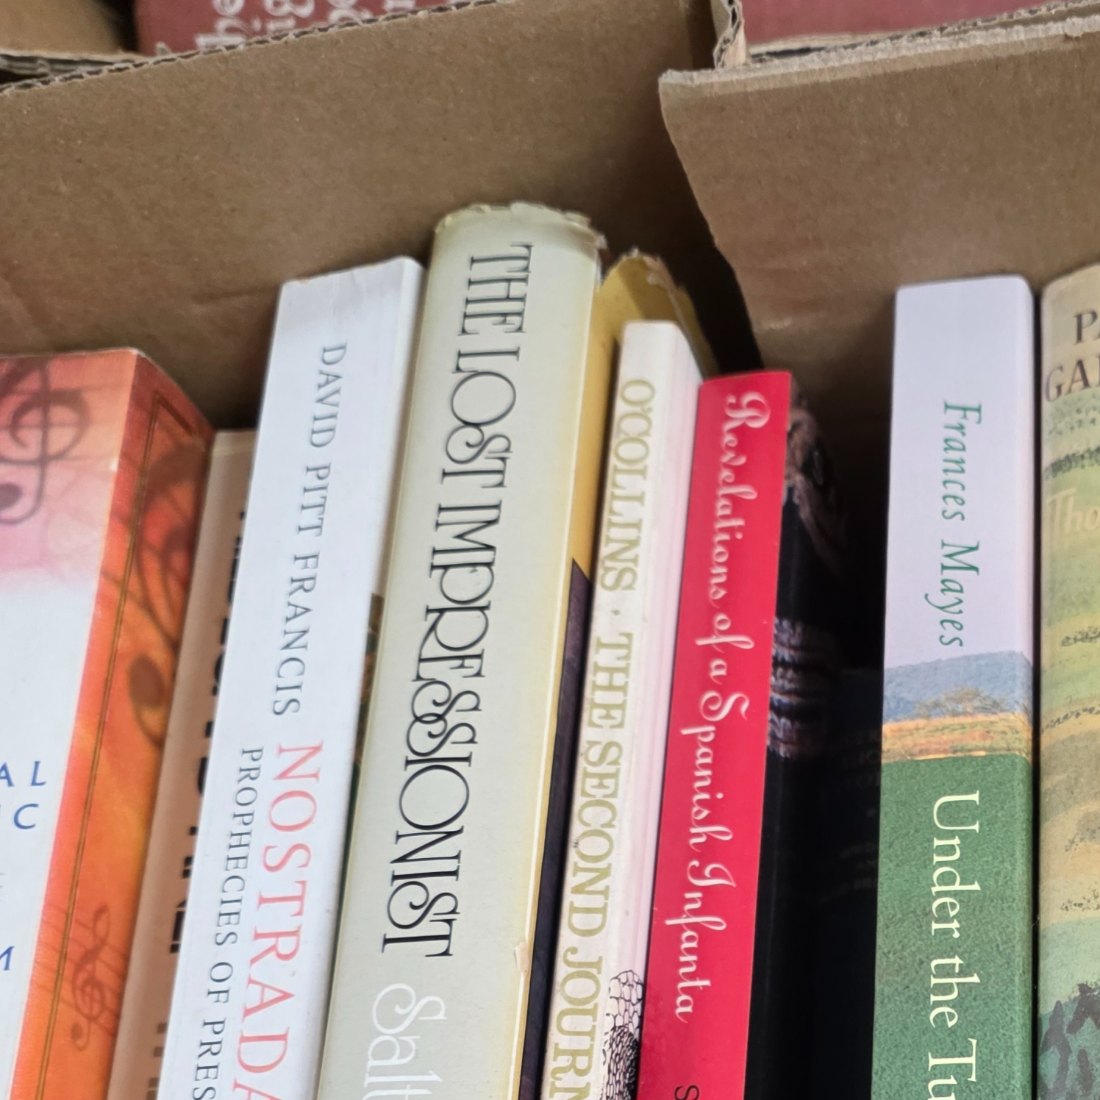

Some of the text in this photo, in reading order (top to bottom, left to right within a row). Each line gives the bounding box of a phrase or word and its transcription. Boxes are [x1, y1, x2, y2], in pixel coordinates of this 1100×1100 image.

[271, 342, 348, 717] DAVID PITT FRANCIS
[600, 379, 656, 593] O'COLLINS
[924, 401, 982, 648] Frances Mayes
[381, 242, 534, 958] THE LOST IMPRESSIONIST
[586, 631, 634, 730] THE
[664, 391, 771, 1024] Revelations of a Spanish Infanta
[214, 746, 264, 947] PROPHECIES
[566, 740, 625, 939] SECOND
[930, 790, 981, 940] Under
[206, 960, 234, 1005] OF
[928, 955, 981, 1030] the
